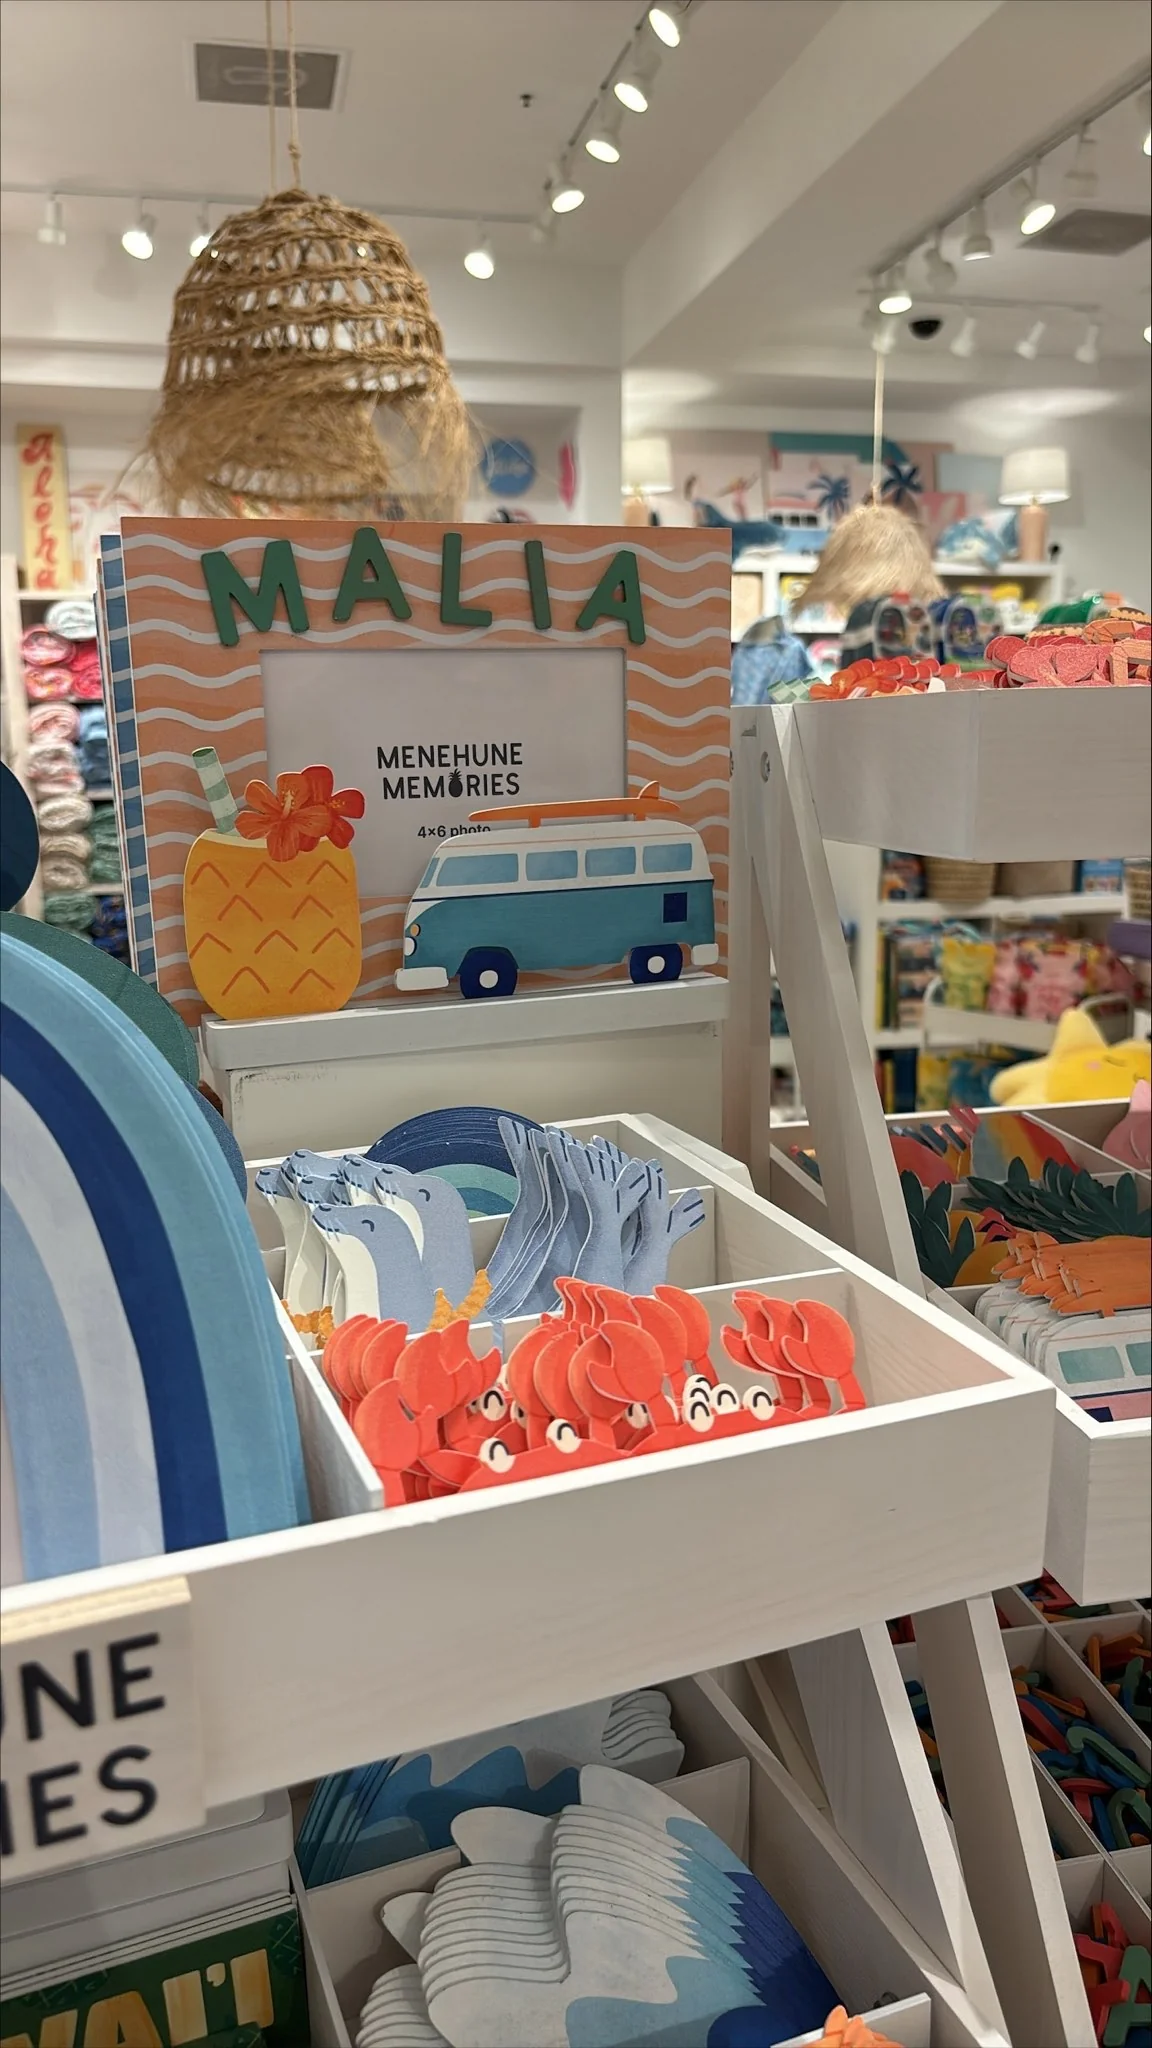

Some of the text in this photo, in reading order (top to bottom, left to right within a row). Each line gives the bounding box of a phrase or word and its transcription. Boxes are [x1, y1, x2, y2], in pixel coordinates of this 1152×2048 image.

[200, 527, 647, 648] MALIA
[377, 742, 523, 769] MENEHUNE
[0, 1632, 166, 1742] NE
